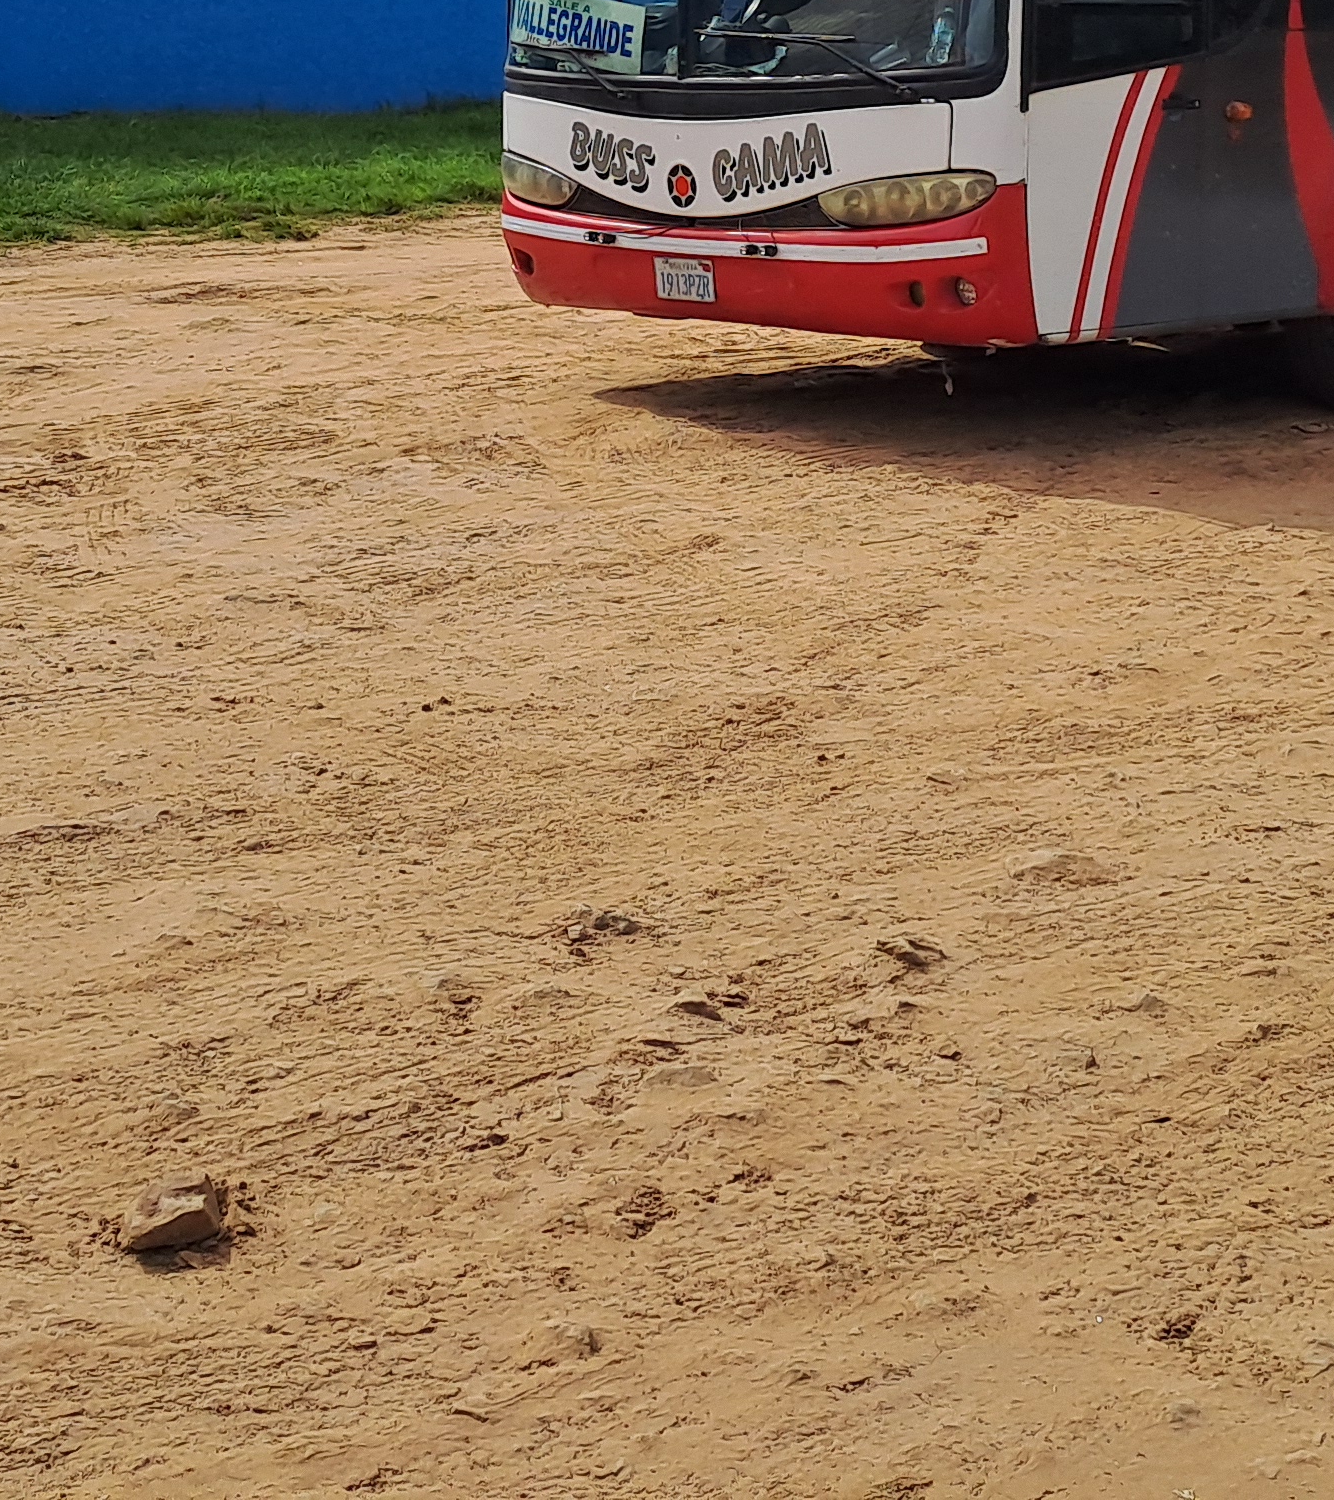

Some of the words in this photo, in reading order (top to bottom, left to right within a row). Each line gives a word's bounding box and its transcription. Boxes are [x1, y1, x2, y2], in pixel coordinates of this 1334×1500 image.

[582, 4, 591, 14] A
[569, 121, 656, 193] BUSS
[712, 123, 833, 203] CAMA
[660, 271, 711, 299] 1913PZR
